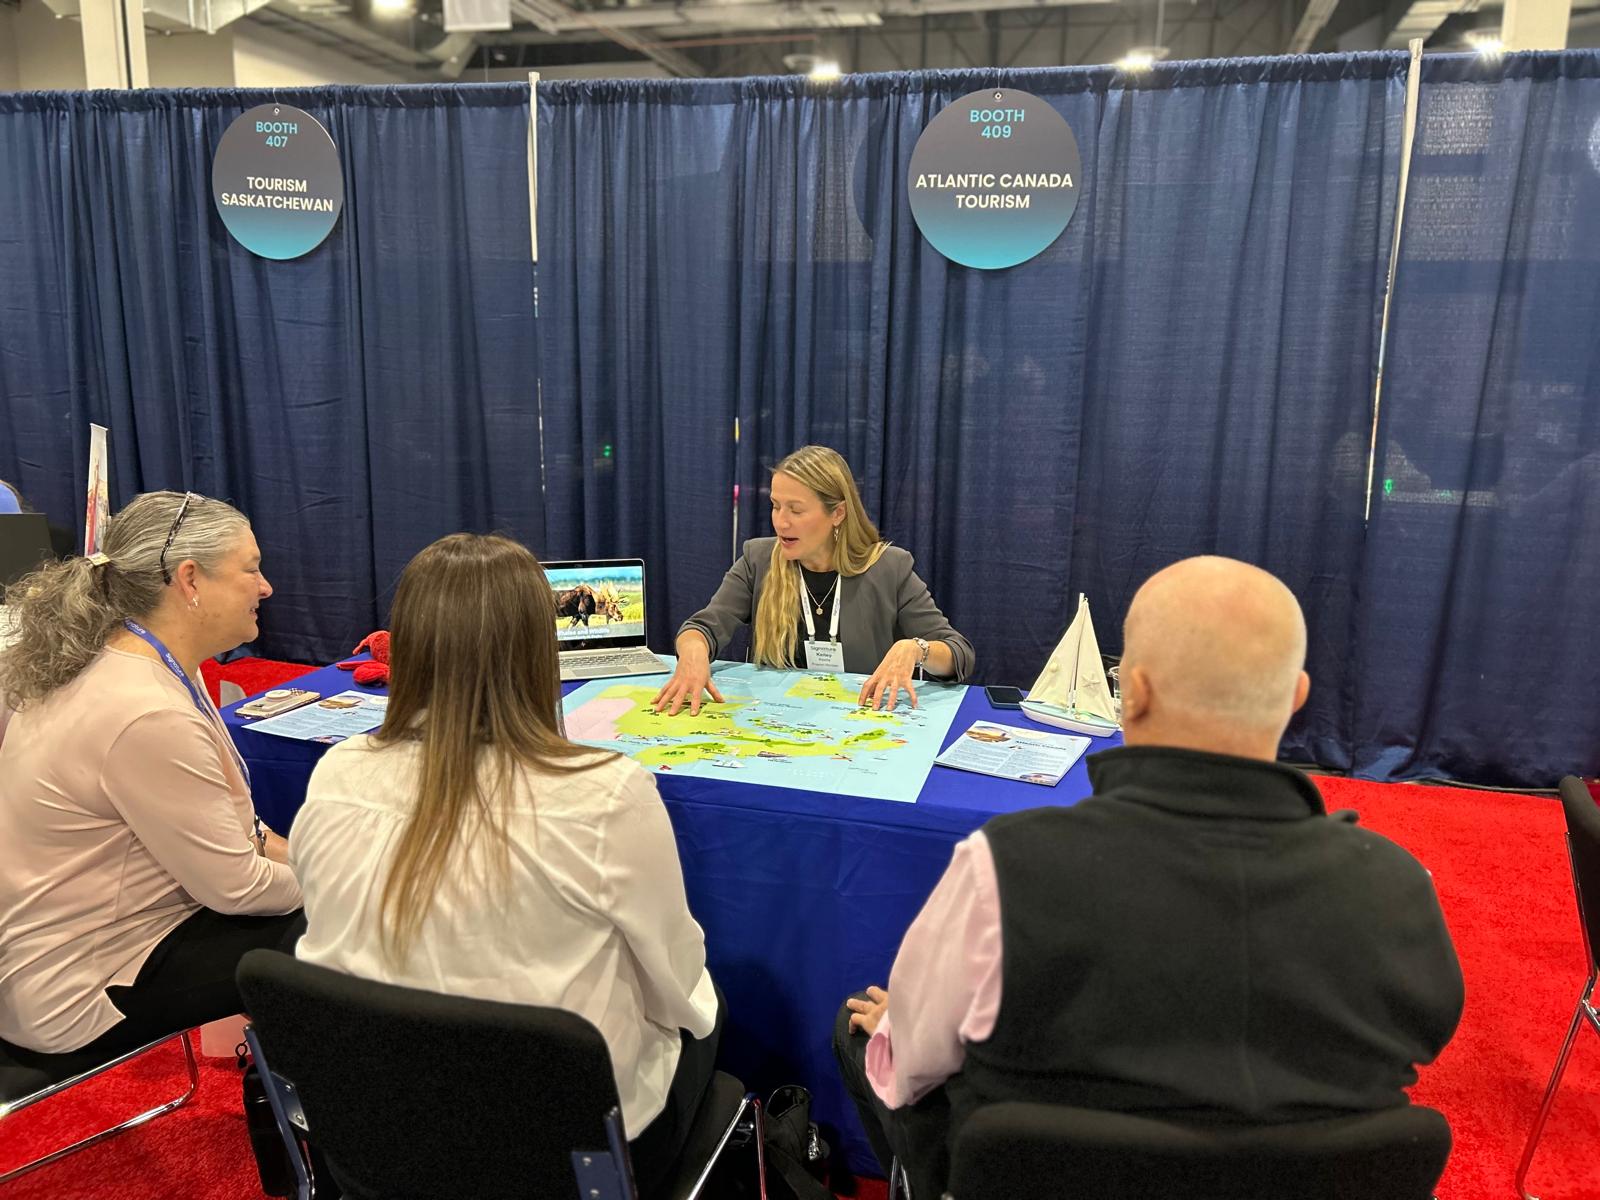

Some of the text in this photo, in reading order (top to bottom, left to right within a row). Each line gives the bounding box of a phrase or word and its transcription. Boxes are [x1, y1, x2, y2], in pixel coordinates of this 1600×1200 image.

[969, 109, 1025, 123] BOOTH
[255, 121, 298, 135] BOOTH
[981, 125, 1012, 139] 409
[265, 136, 288, 148] 407
[246, 176, 307, 193] TOURISM
[915, 173, 1074, 189] ATLANTIC CANADA
[221, 192, 334, 212] SASKATCHEWAN
[955, 194, 1031, 209] TOURISM
